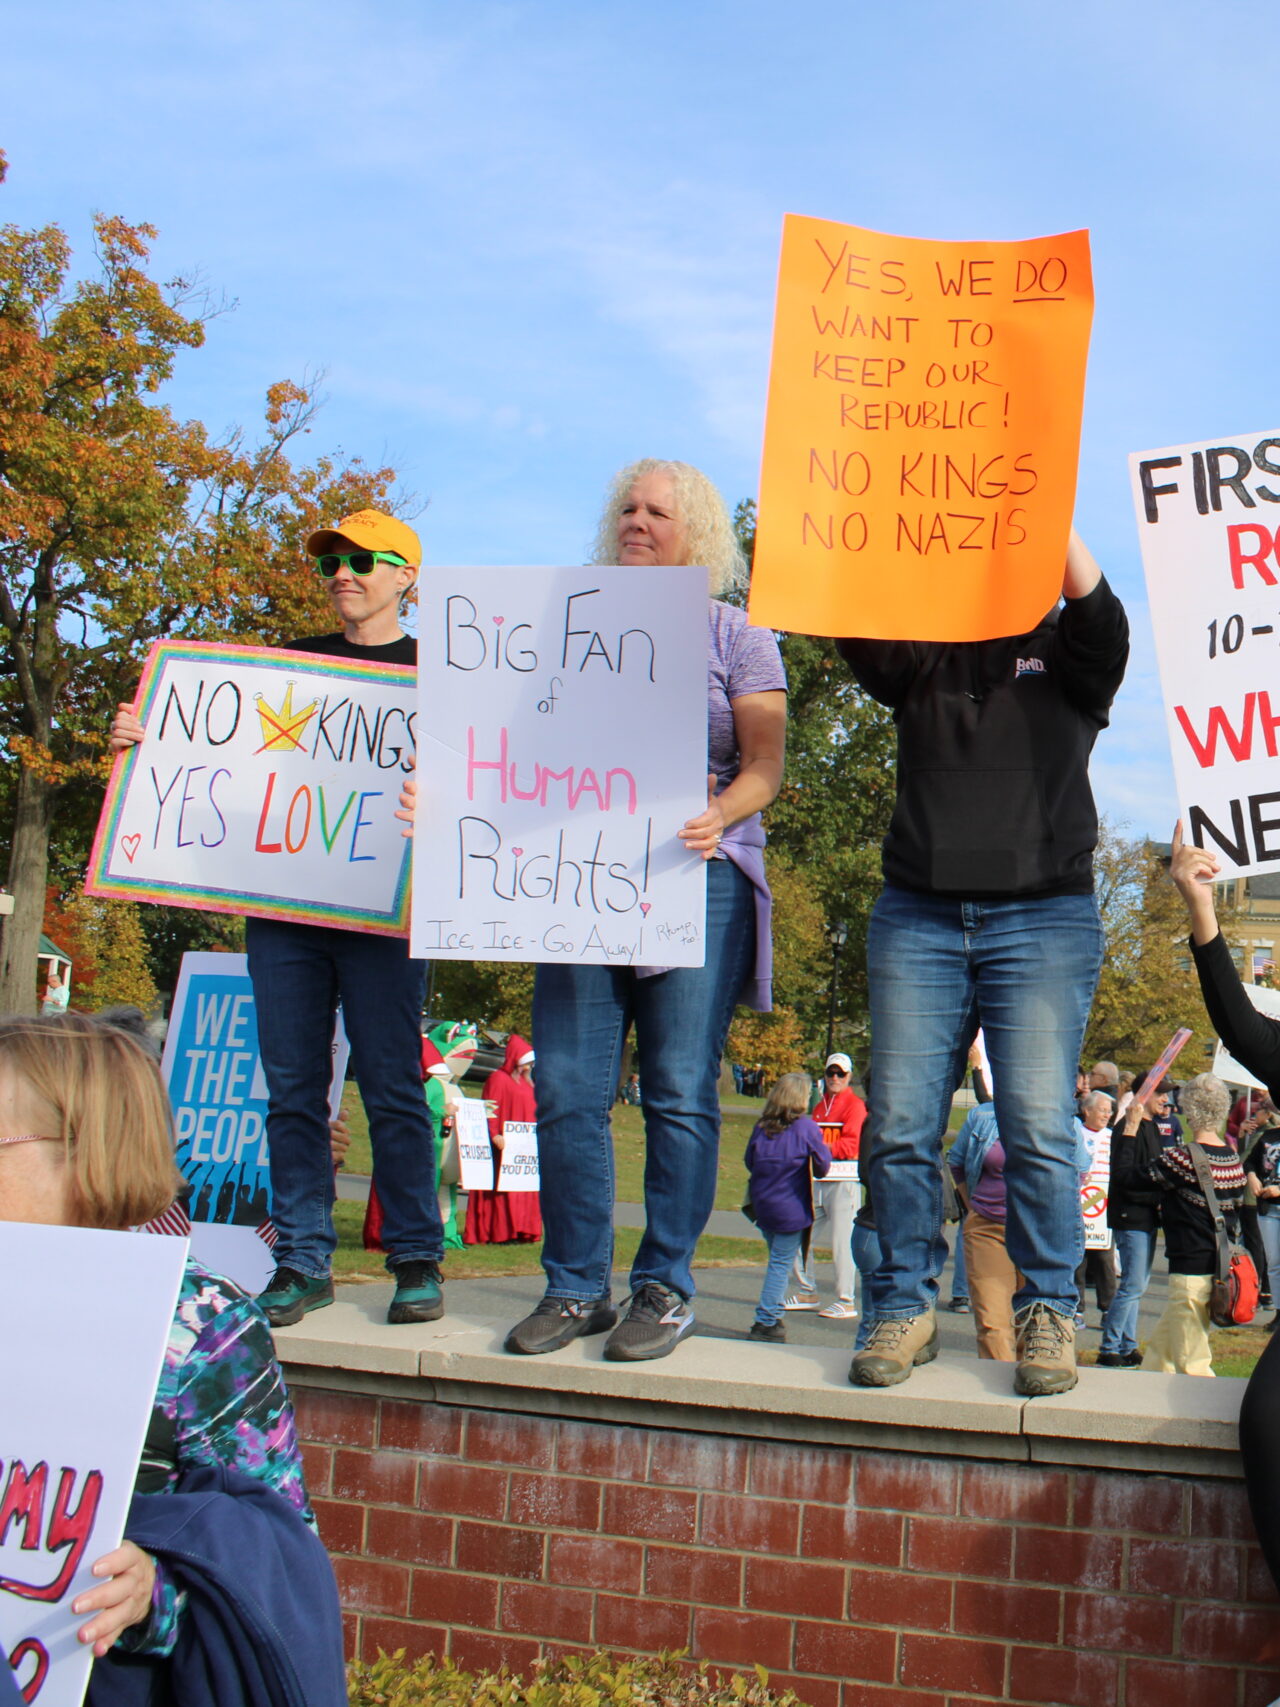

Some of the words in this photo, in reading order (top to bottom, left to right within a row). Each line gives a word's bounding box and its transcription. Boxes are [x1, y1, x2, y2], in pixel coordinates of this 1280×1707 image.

[814, 238, 914, 301] YES,
[935, 259, 994, 296] WE
[1015, 257, 1067, 295] DO
[811, 305, 919, 343] WANT
[948, 318, 993, 348] TO
[812, 350, 906, 388] KEEP
[925, 360, 1003, 388] OUR
[809, 447, 871, 496] NO
[900, 452, 1038, 499] KINGS
[802, 512, 868, 552] NO
[896, 508, 1027, 555] NAZIS
[537, 676, 563, 715] of
[157, 679, 241, 747] NO
[311, 693, 418, 775] KINGS
[150, 765, 233, 850] YES
[255, 771, 385, 862] LOVE
[195, 993, 254, 1047] WE
[184, 1049, 253, 1106] THE
[502, 1165, 522, 1174] YOU
[524, 1165, 539, 1175] DO
